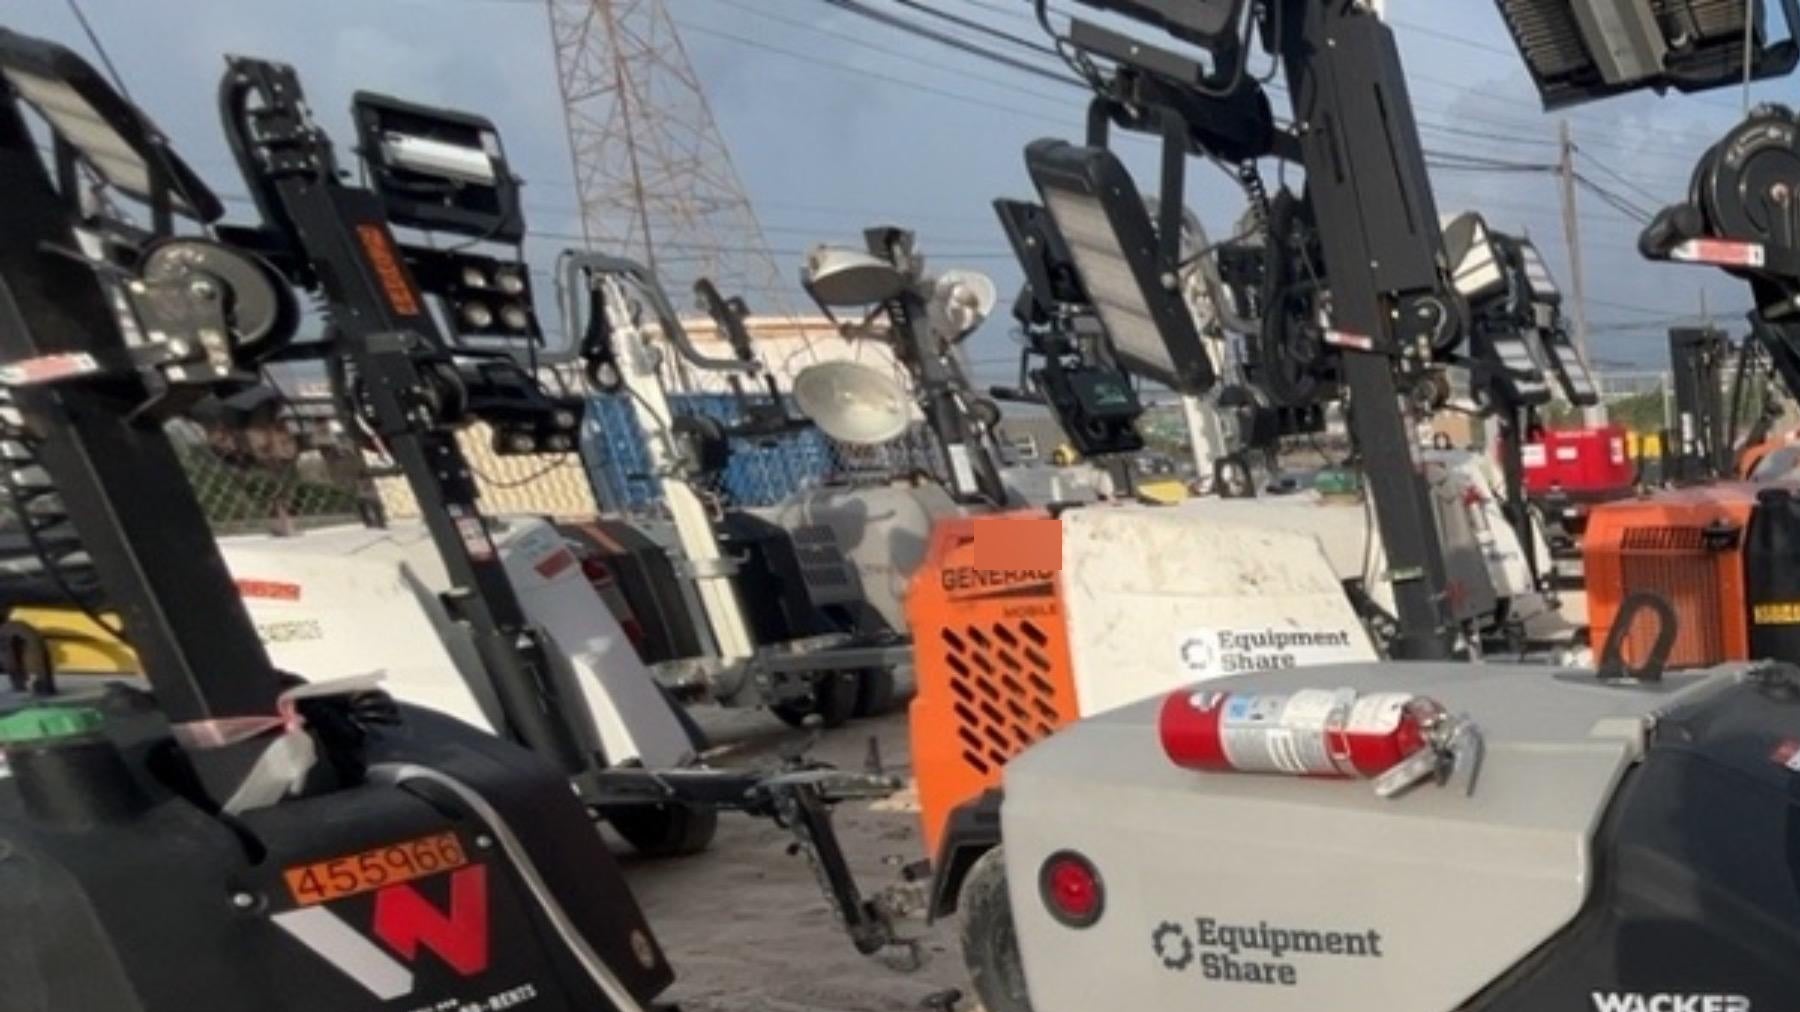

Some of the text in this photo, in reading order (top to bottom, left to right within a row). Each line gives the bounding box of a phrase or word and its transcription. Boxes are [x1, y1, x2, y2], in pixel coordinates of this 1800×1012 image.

[1216, 628, 1350, 651] Equipment
[1220, 651, 1296, 673] Share
[297, 838, 461, 897] 455966
[1195, 918, 1382, 957] Equipment
[1200, 952, 1297, 985] Share
